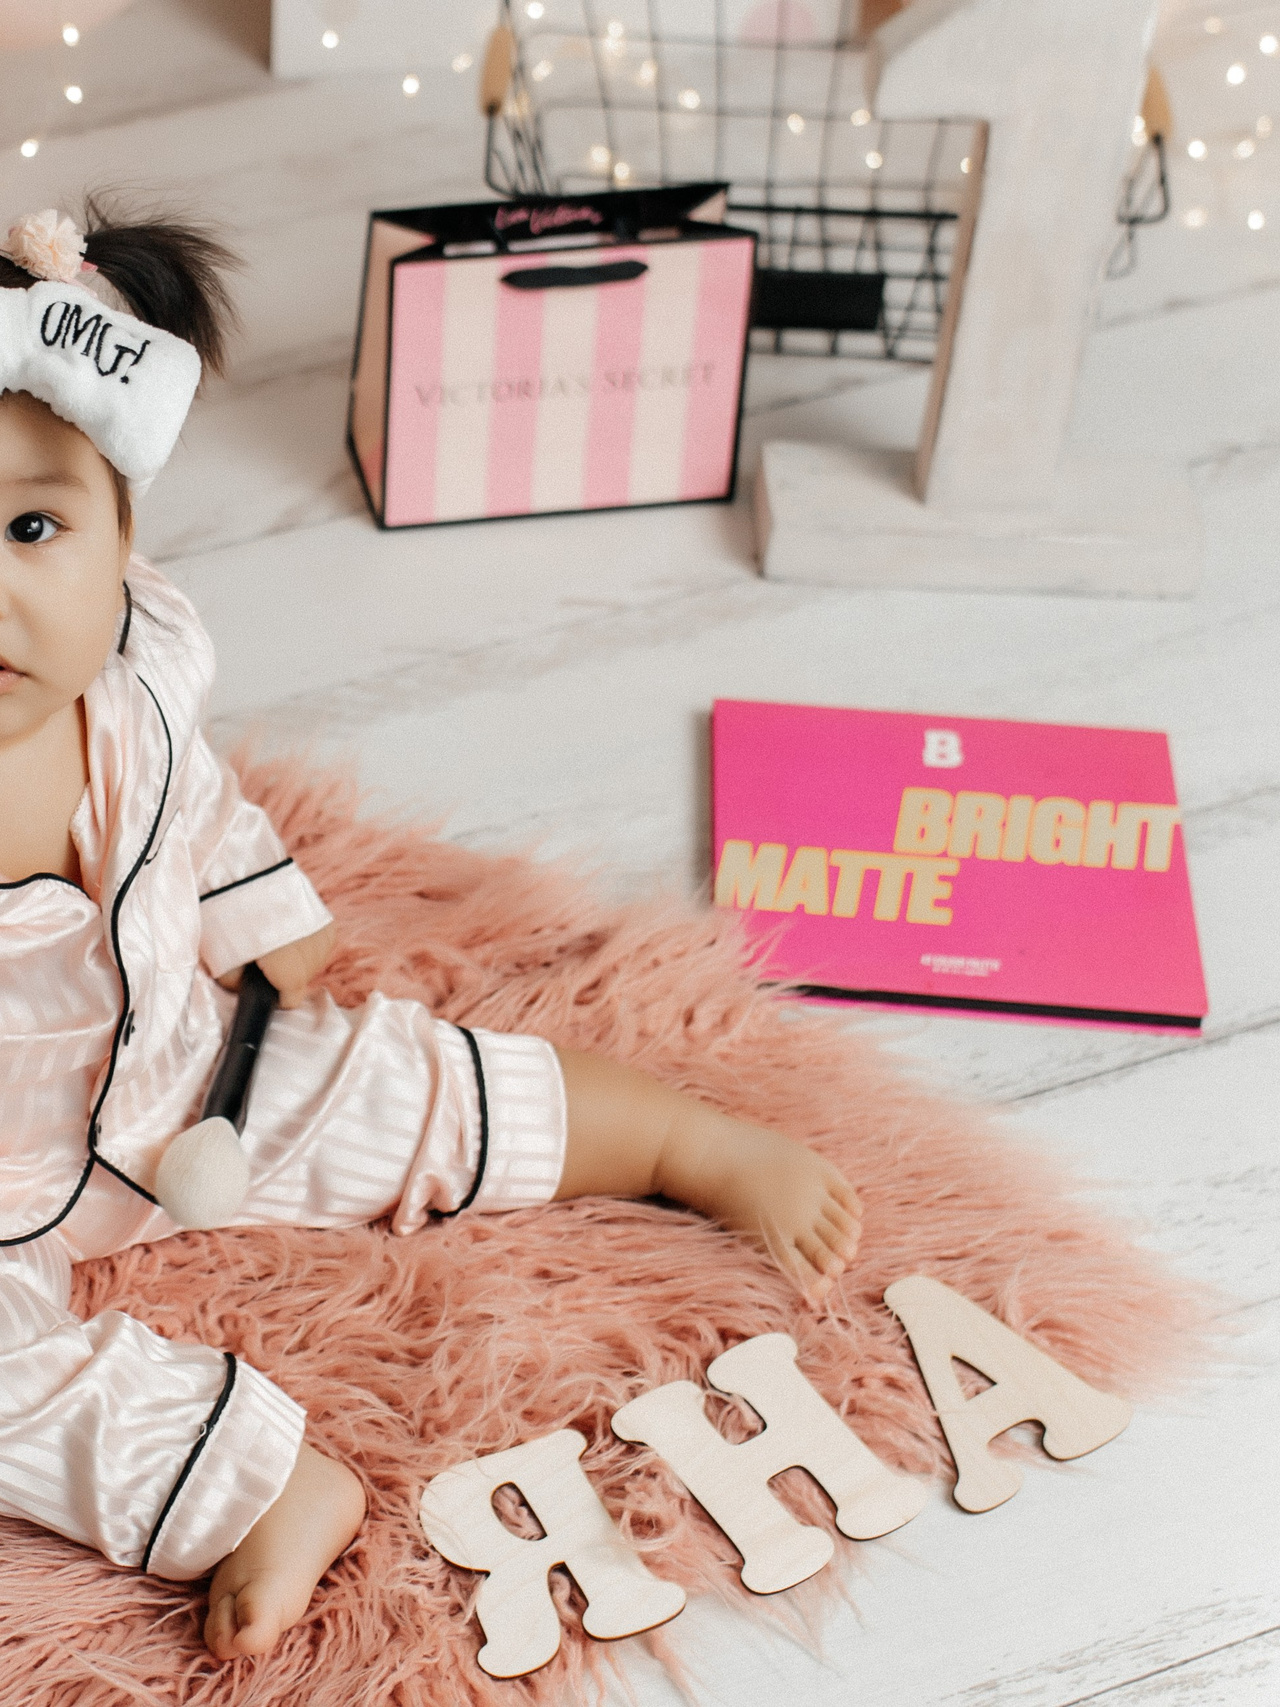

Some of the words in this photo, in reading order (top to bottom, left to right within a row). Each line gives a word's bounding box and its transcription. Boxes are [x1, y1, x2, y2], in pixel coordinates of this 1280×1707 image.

[40, 299, 151, 385] OMG!
[603, 362, 716, 391] SECRET
[922, 728, 964, 769] B
[892, 786, 1182, 873] BRIGHT
[715, 838, 961, 927] MATTE
